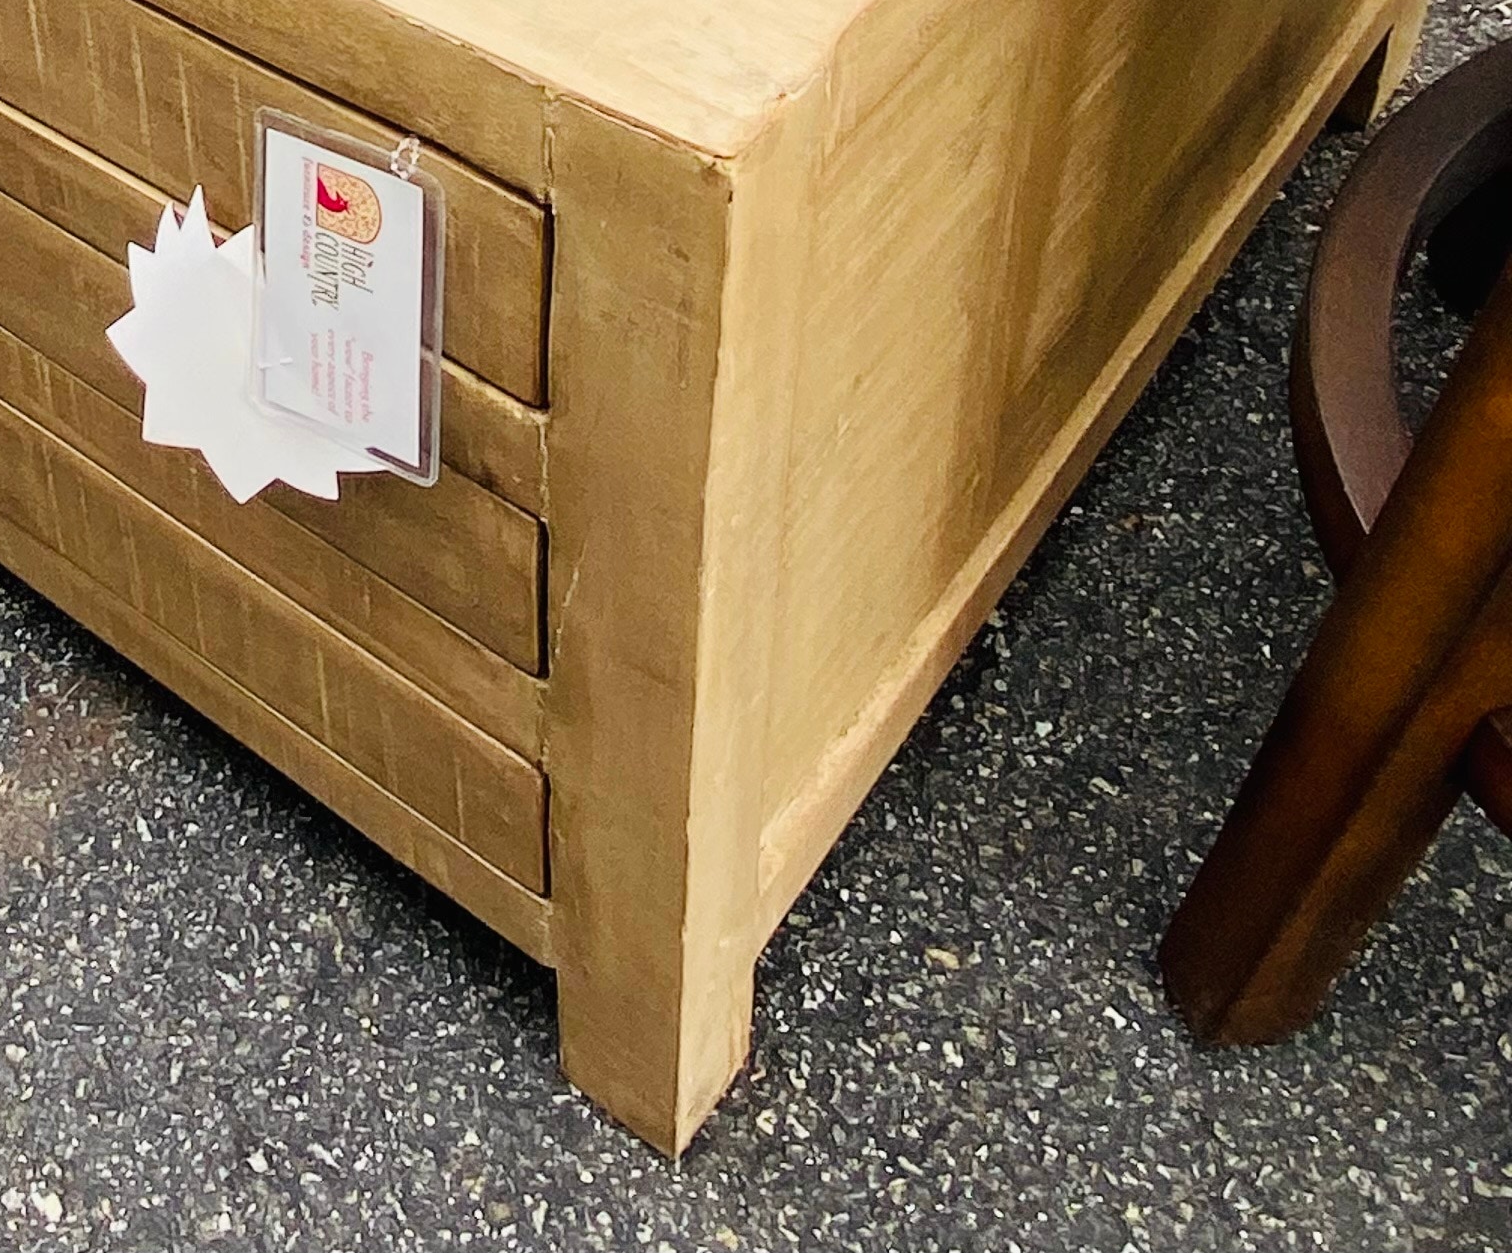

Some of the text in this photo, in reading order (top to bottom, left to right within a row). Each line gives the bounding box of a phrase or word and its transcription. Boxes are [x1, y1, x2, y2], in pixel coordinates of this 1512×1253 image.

[302, 156, 314, 211] furniture
[300, 229, 313, 269] design
[307, 232, 339, 311] COUNTRY
[341, 241, 374, 294] HIGH
[327, 329, 336, 361] every
[327, 361, 337, 400] aspect
[343, 372, 357, 408] factor
[359, 350, 374, 423] Bringing the
